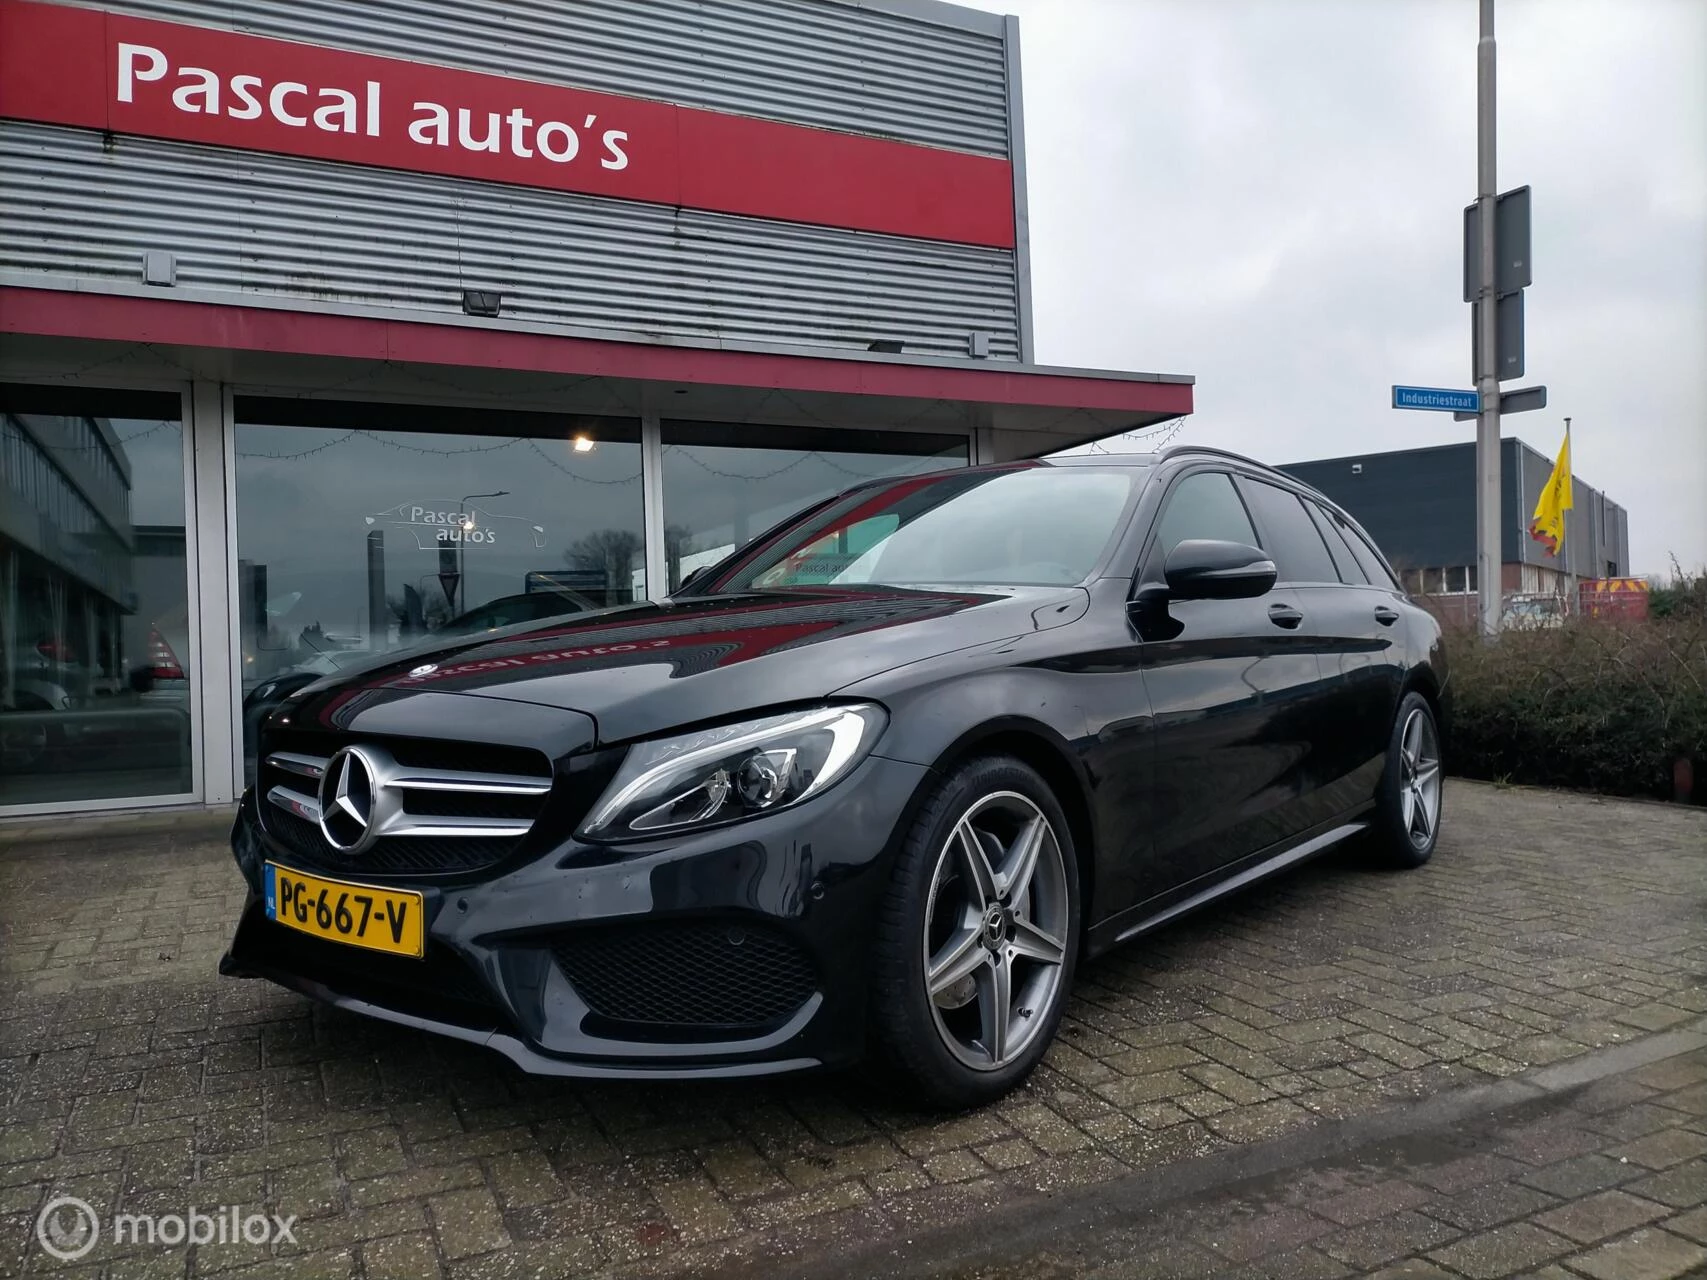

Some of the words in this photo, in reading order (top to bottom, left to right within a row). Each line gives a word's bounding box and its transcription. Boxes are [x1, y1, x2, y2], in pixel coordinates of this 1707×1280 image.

[117, 43, 380, 137] Pascal
[408, 101, 629, 170] auto's
[1402, 392, 1472, 407] Industriestraat
[411, 506, 475, 525] Pascal
[436, 528, 496, 543] auto's
[280, 876, 407, 944] PG-667-V
